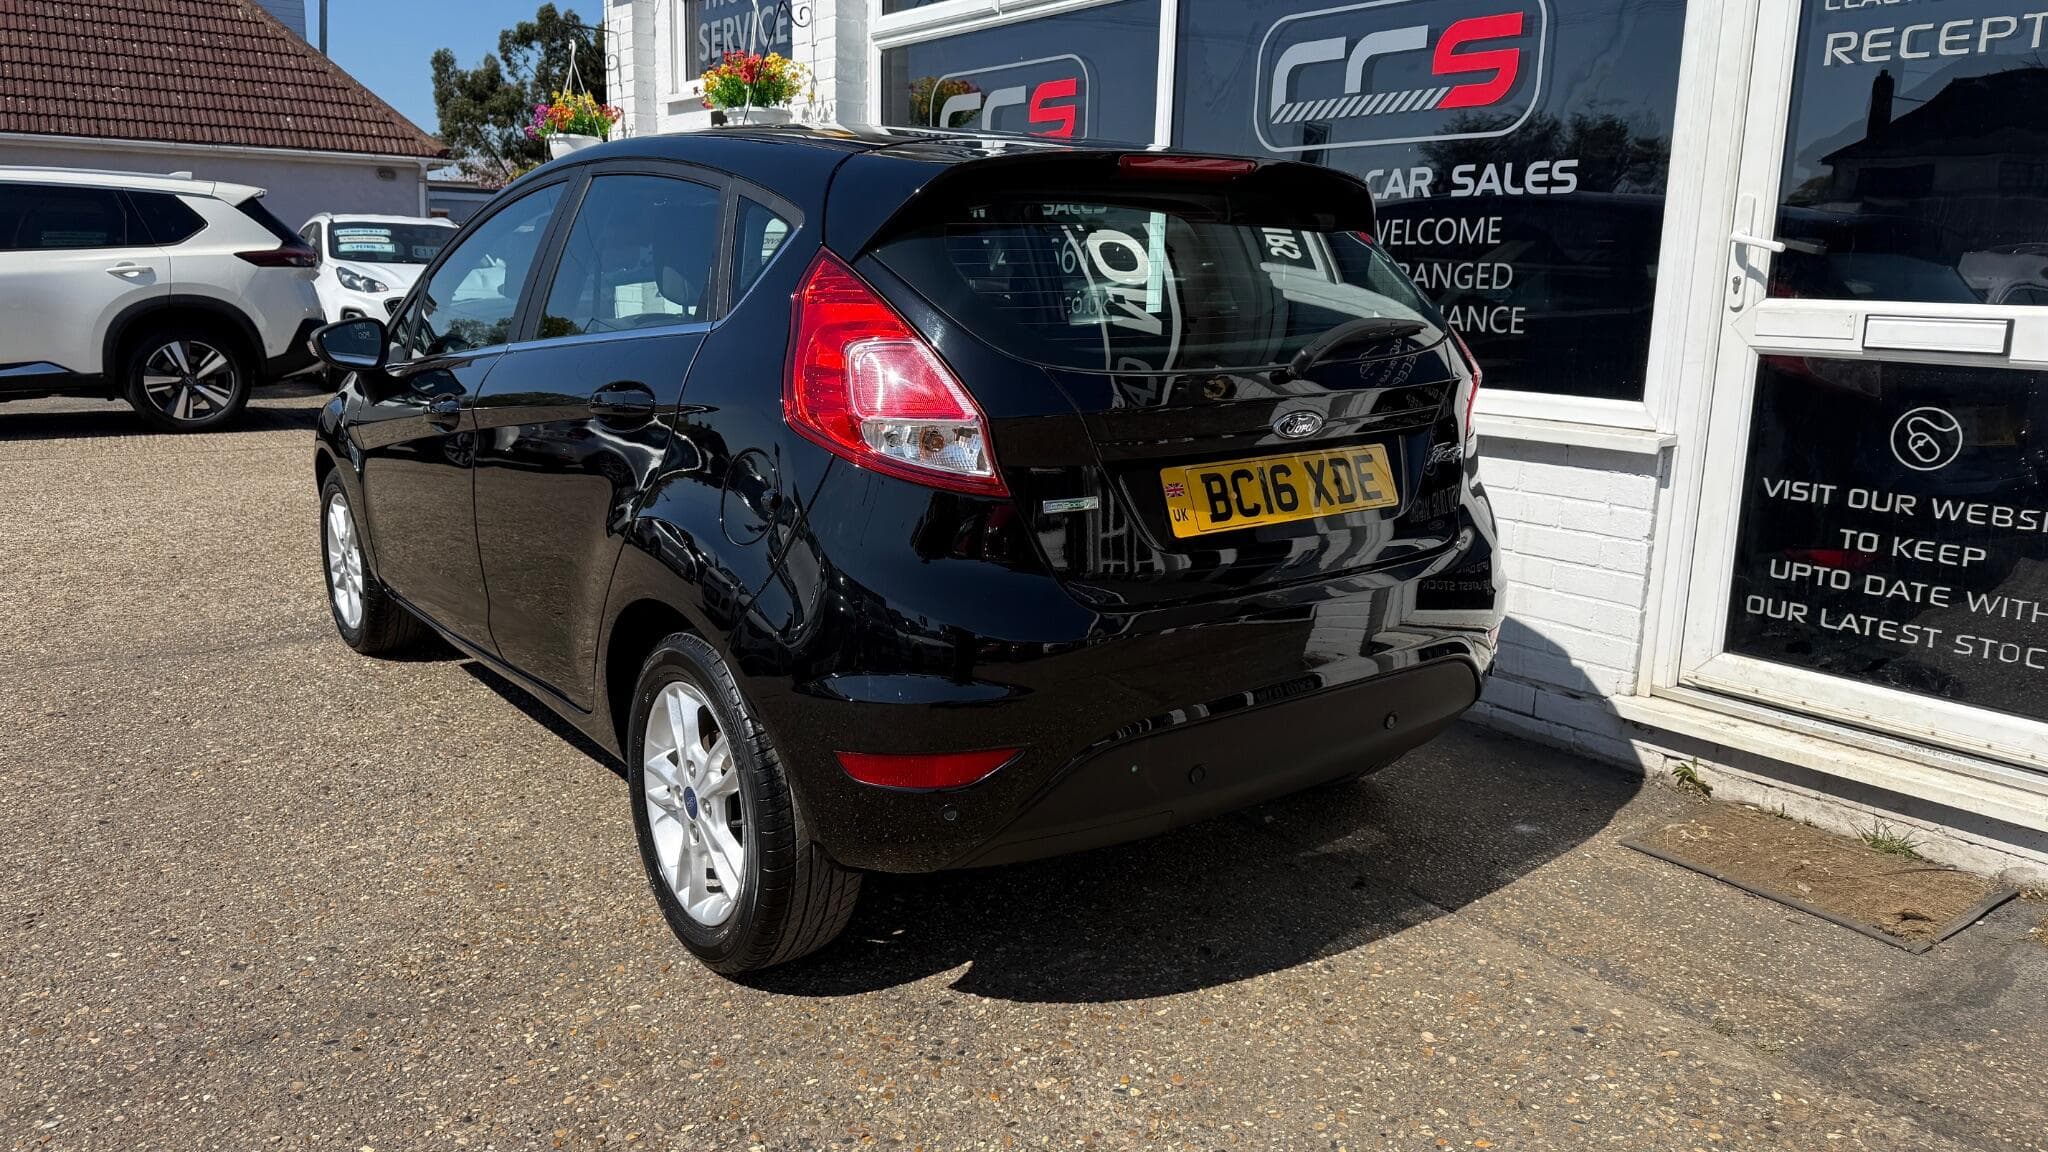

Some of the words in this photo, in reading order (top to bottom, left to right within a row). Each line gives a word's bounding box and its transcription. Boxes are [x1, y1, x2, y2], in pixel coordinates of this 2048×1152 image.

[699, 4, 788, 61] SERVICE
[1823, 12, 2048, 66] RECEPT
[1365, 166, 1433, 199] CAR
[1451, 159, 1578, 197] SALES
[1440, 304, 1526, 334] ANCE
[1200, 463, 1299, 523] BC16
[1303, 454, 1384, 508] XDE
[1763, 477, 1837, 505] VISIT
[1847, 488, 1917, 516] OUR
[1173, 508, 1189, 522] UK
[1840, 528, 1880, 553] TO
[1892, 537, 1987, 567] KEEP
[1769, 558, 1850, 590] UPTO
[1864, 574, 1951, 608] DATE
[1967, 591, 2048, 623] WITH
[1746, 595, 1808, 623] OUR
[1820, 608, 1942, 648] LATEST
[1954, 635, 2048, 669] STOC
